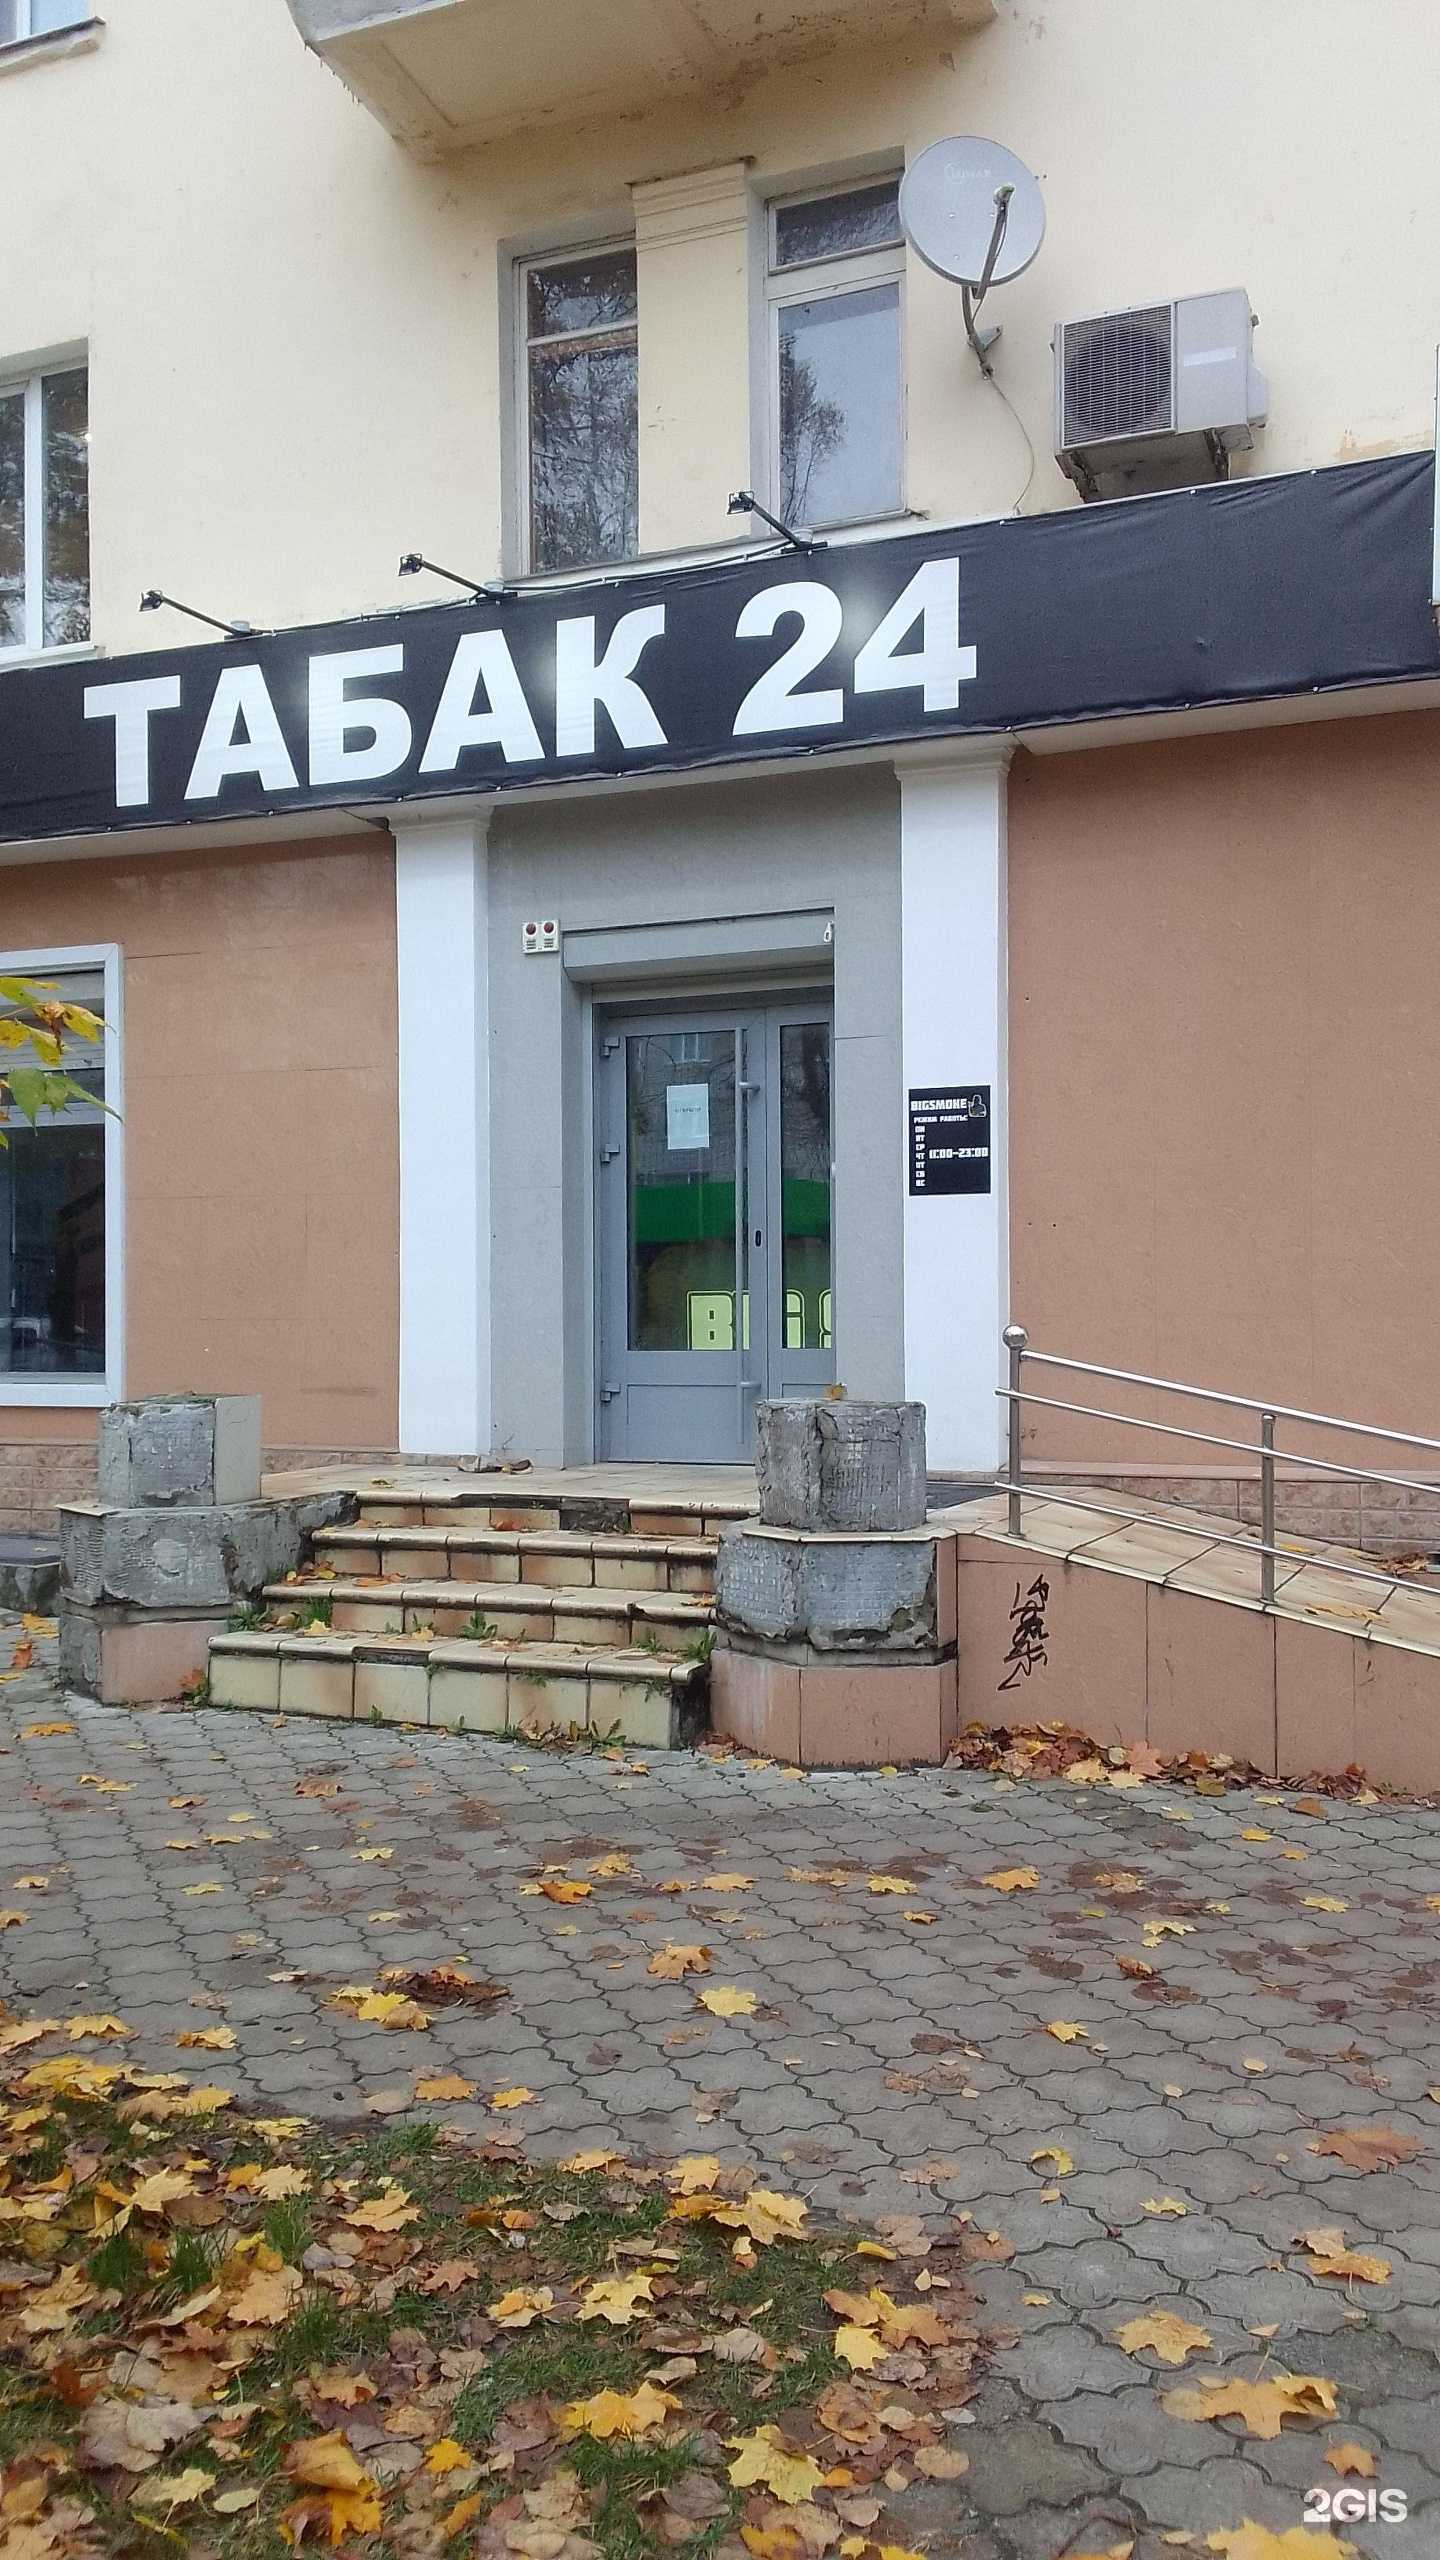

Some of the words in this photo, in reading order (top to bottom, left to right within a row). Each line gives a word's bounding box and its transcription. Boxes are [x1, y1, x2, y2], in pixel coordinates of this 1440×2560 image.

[83, 604, 669, 807] ТАБАК
[733, 557, 977, 736] 24
[911, 1098, 967, 1111] BIGSMOKE
